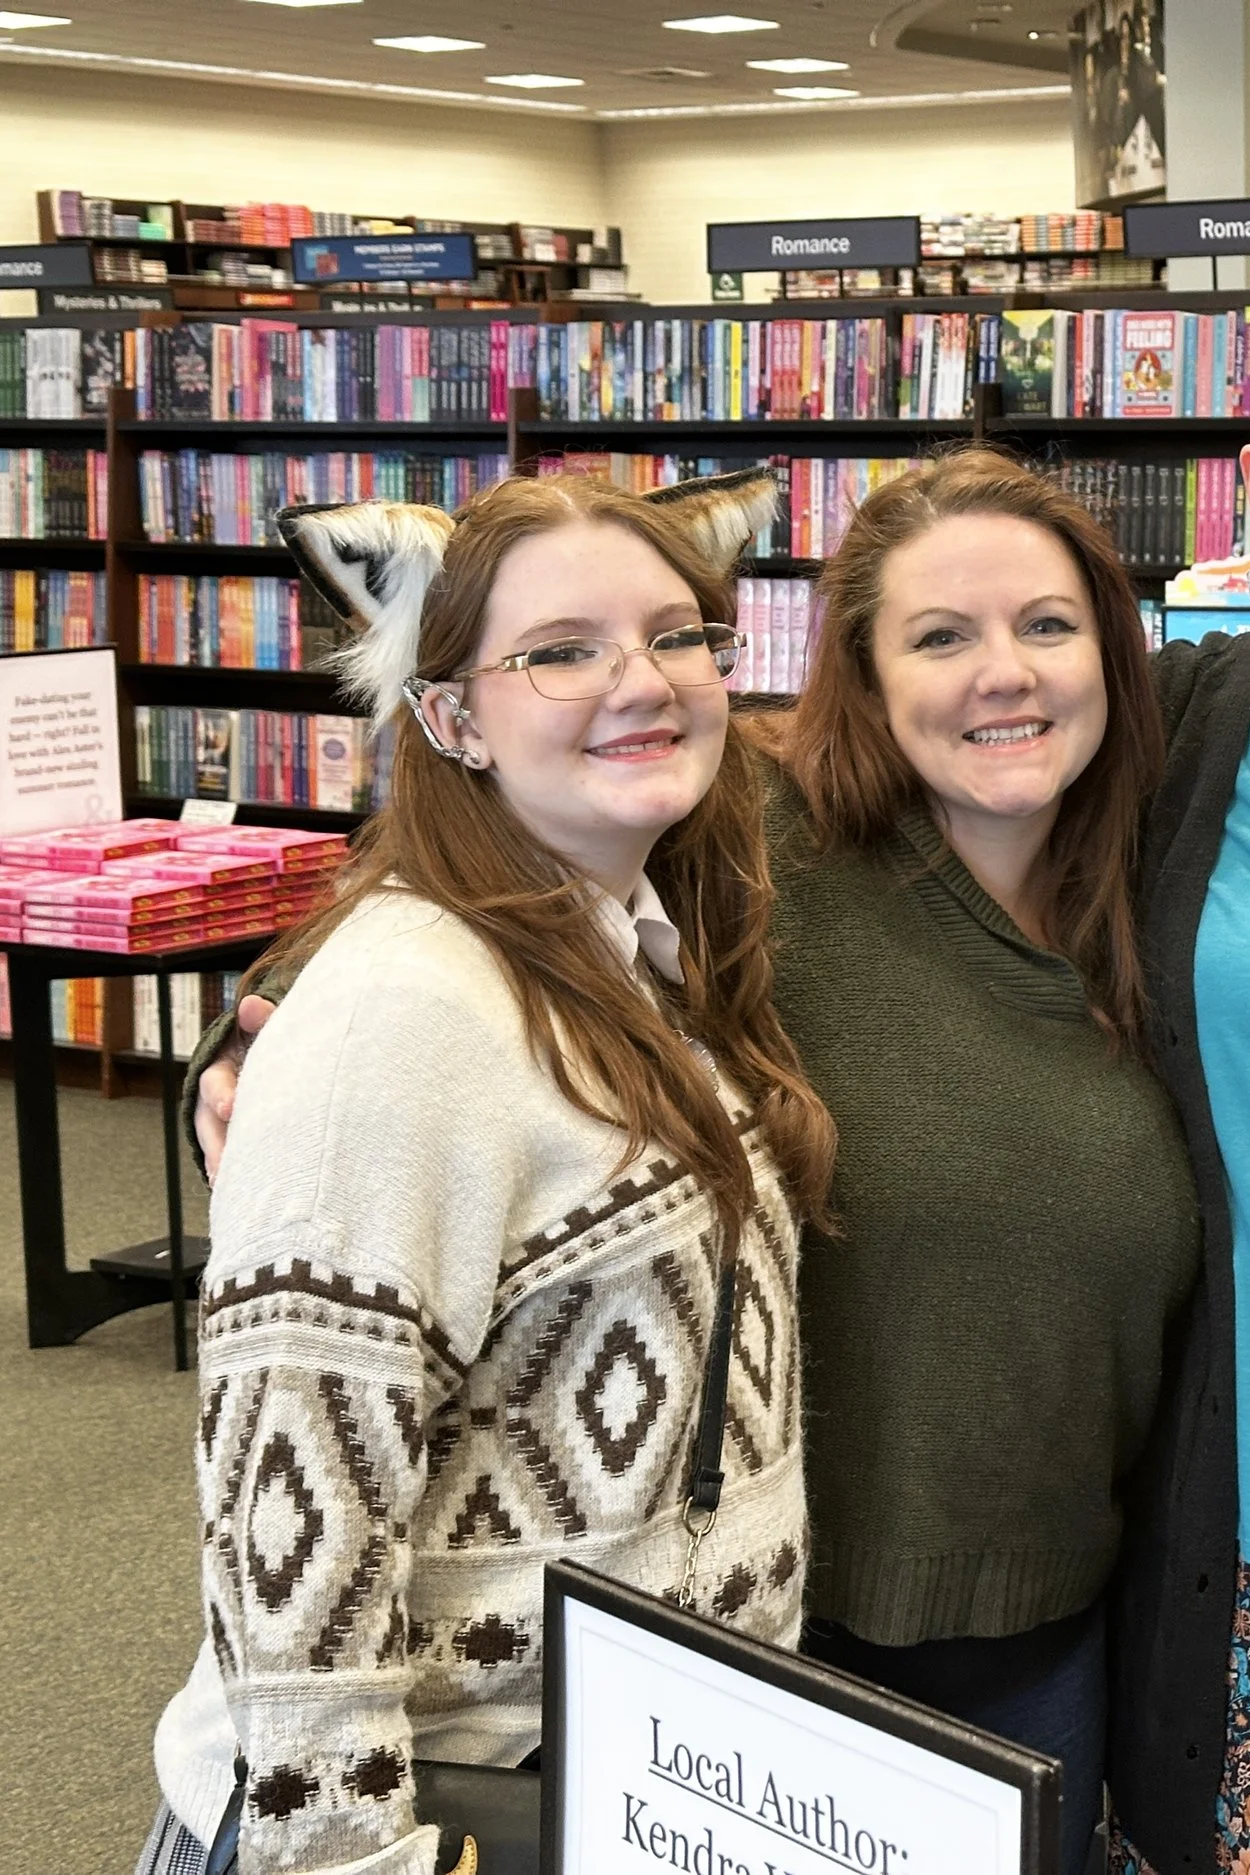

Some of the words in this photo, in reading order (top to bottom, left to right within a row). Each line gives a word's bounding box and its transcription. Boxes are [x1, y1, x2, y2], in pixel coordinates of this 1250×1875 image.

[771, 235, 851, 255] Romance
[54, 294, 105, 311] Mysteries
[108, 295, 119, 310] &
[119, 295, 162, 310] Thrillers
[15, 693, 69, 706] Fake-dating
[79, 707, 97, 717] that
[8, 731, 31, 742] hard
[8, 750, 27, 760] love
[29, 747, 49, 758] with
[649, 1715, 746, 1808] Local
[756, 1770, 908, 1875] Author:
